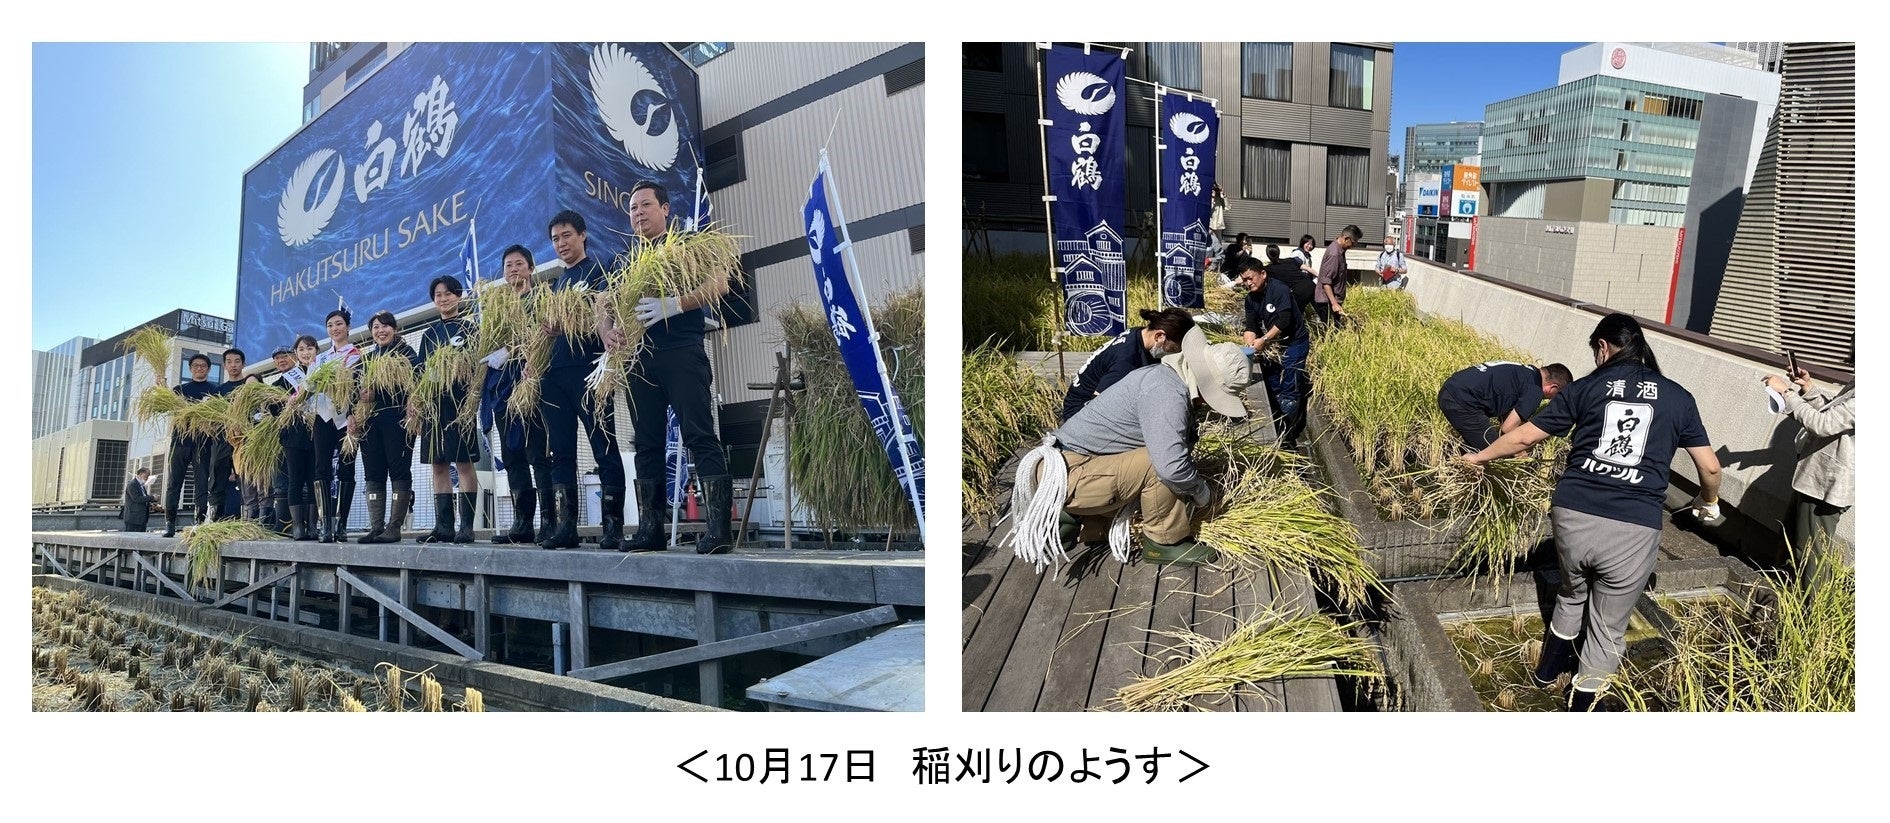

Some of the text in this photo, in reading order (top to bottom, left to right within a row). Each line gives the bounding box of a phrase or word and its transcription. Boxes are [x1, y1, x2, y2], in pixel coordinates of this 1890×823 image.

[354, 74, 459, 204] 白鶴
[1071, 121, 1104, 191] 白鶴
[1179, 147, 1202, 197] 白鶴
[270, 189, 470, 307] HAKUTSURU SAKE
[1606, 379, 1658, 400] 清酒
[1604, 408, 1641, 459] 白鶴
[1580, 457, 1644, 485] ハクツル
